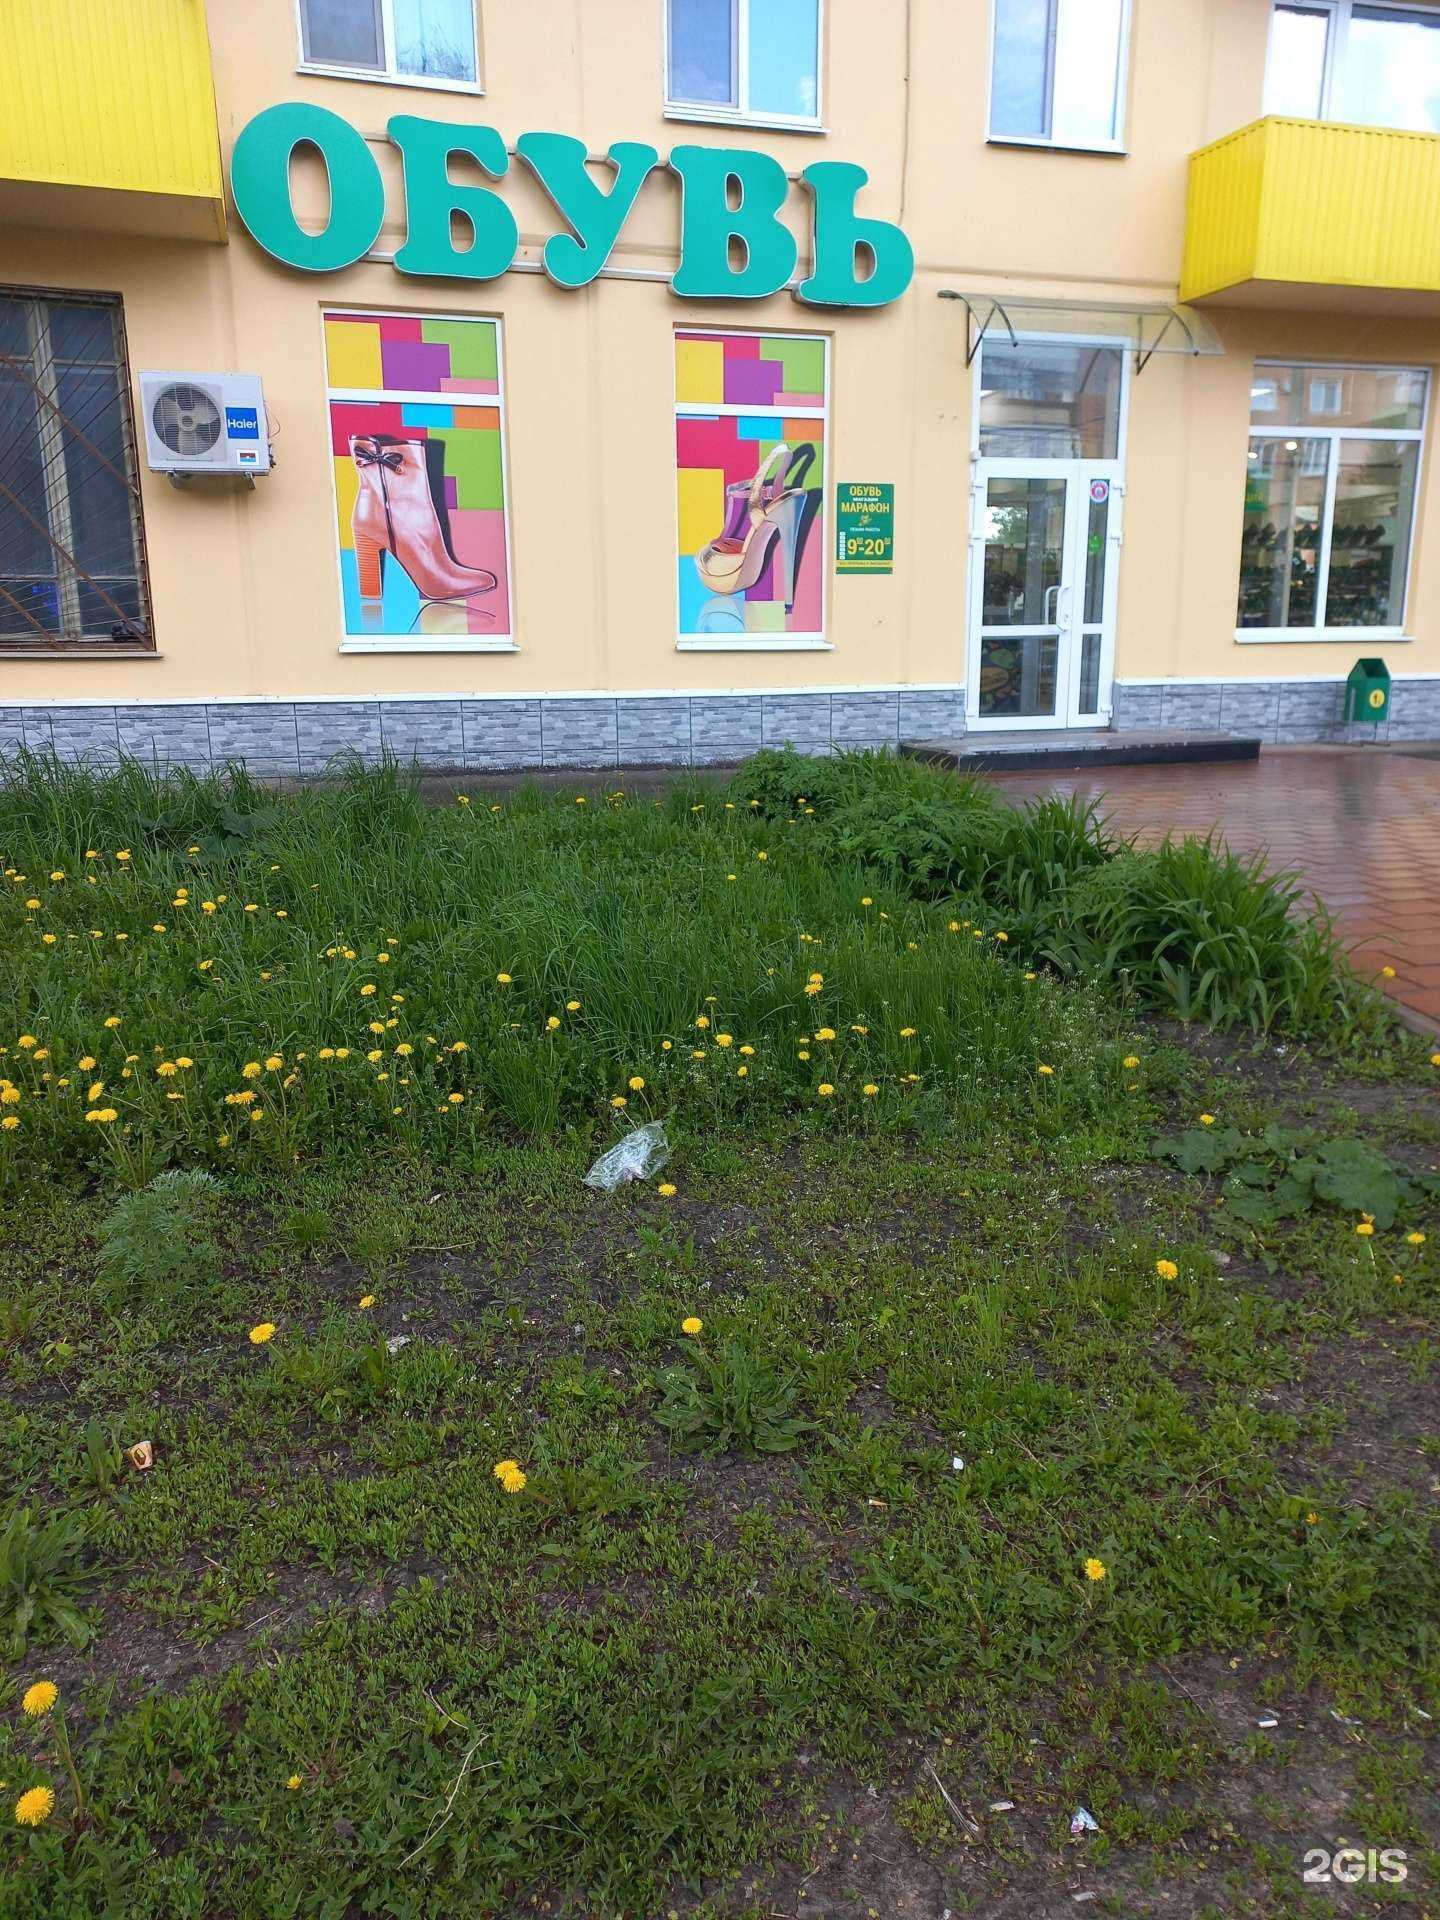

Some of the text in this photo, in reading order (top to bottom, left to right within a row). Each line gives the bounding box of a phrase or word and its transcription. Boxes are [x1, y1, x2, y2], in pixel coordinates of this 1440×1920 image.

[231, 102, 914, 307] ОБУВЬ
[227, 418, 257, 429] Haier
[849, 485, 882, 496] ОБУВЬ
[841, 502, 890, 513] МАРАФОН
